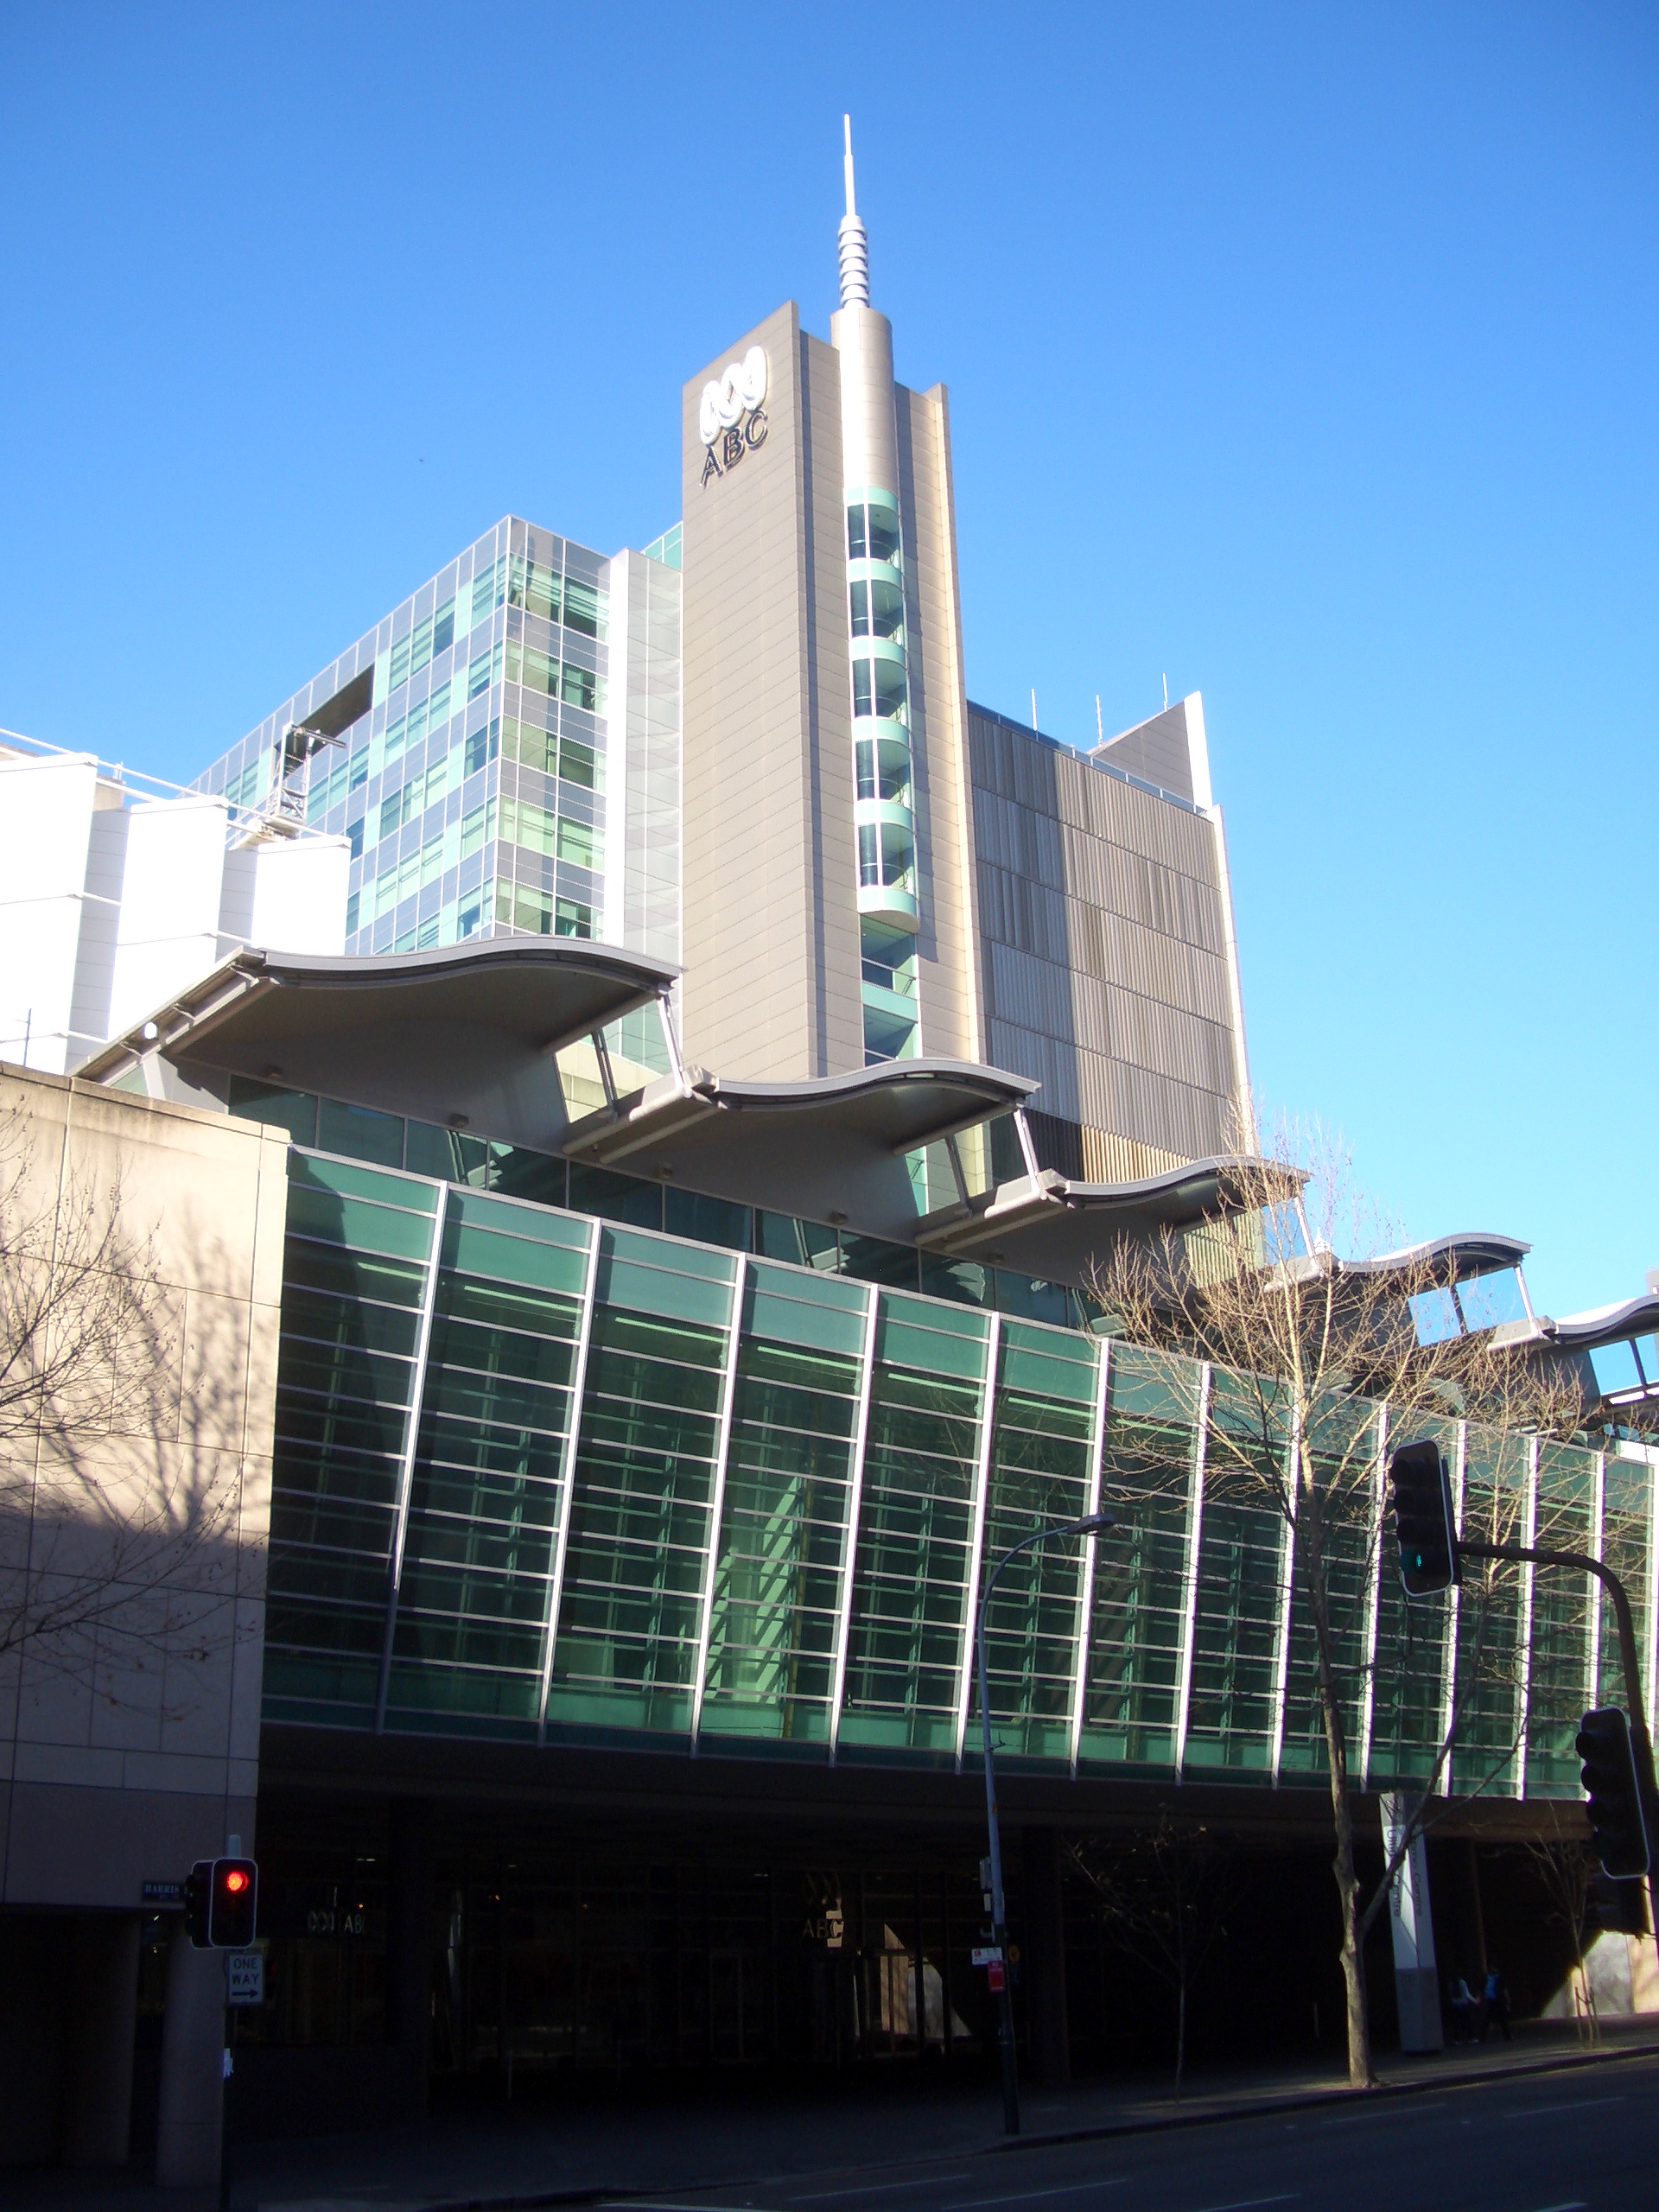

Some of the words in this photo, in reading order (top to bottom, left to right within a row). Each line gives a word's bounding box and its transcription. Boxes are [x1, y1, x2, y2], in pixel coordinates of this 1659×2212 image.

[699, 410, 768, 489] ABC
[803, 1918, 844, 1938] ABC
[233, 1957, 258, 1969] ONE
[232, 1974, 259, 1985] WAY
